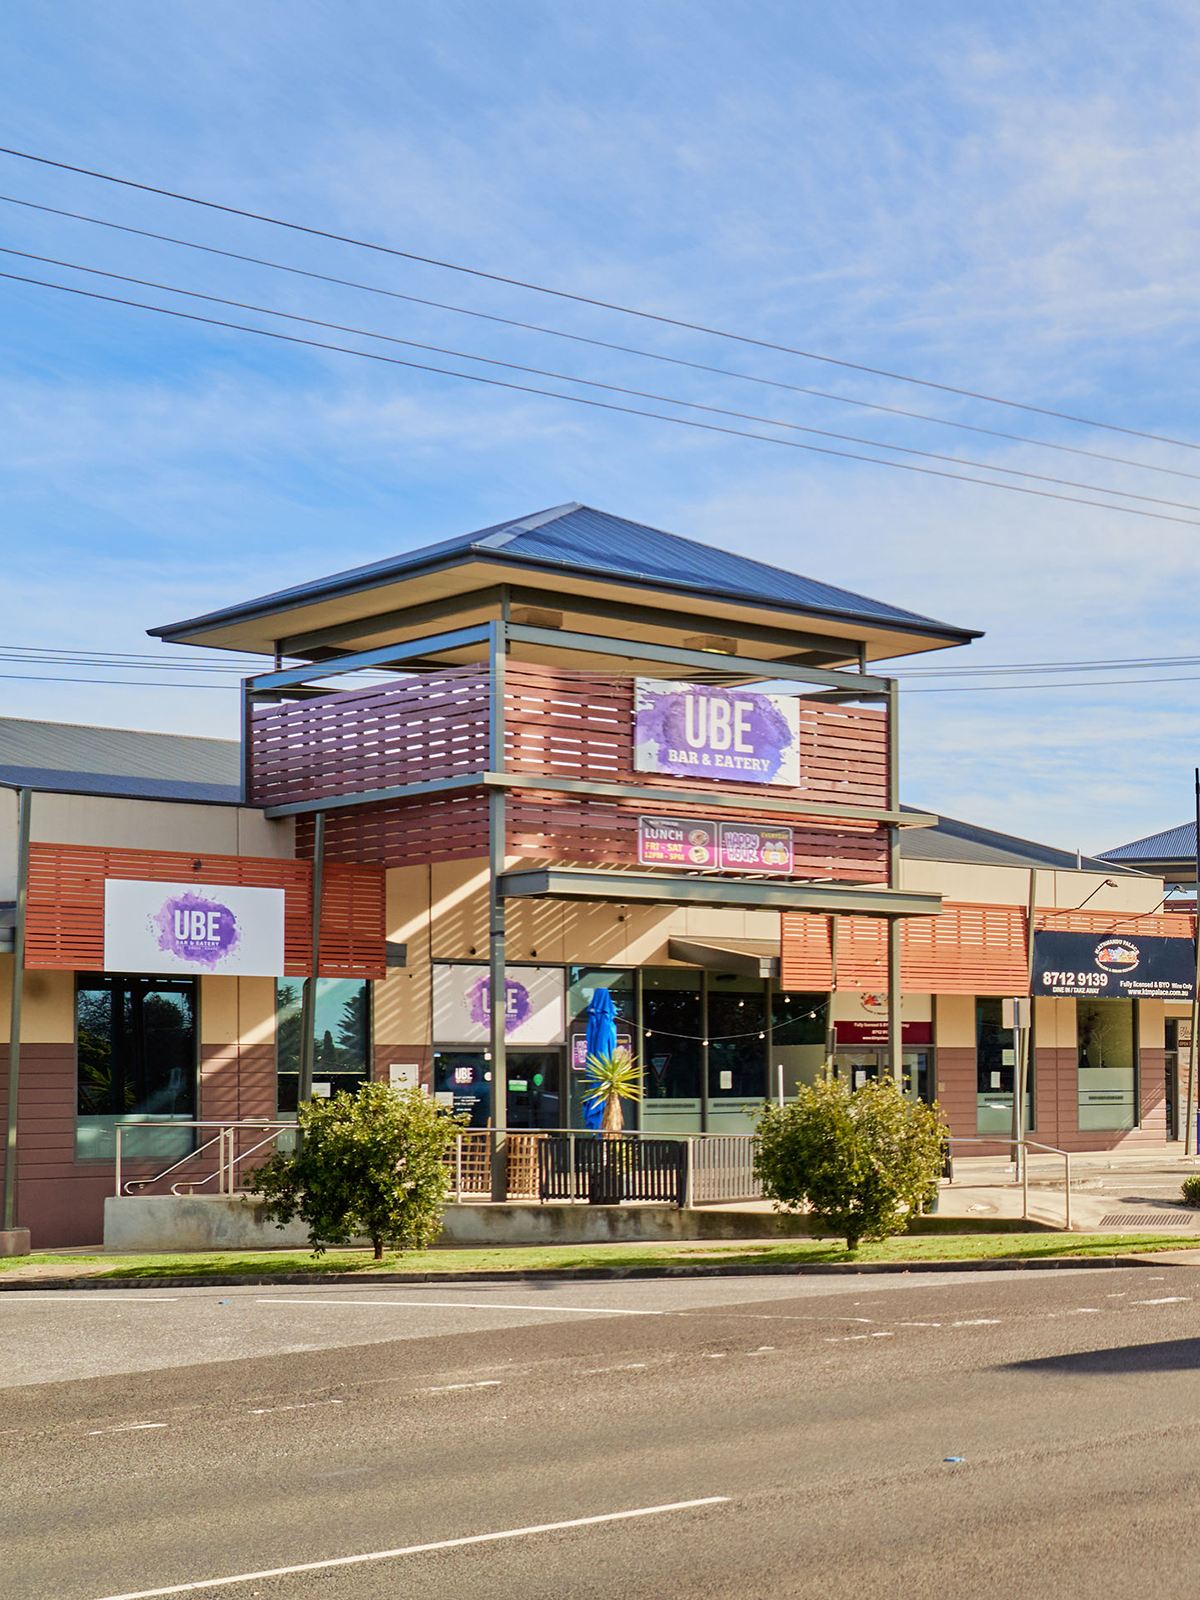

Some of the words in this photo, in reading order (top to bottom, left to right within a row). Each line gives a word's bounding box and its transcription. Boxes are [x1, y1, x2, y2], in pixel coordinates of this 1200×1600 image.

[685, 694, 754, 754] UBE
[668, 749, 699, 765] BAR
[702, 753, 711, 766] &
[714, 754, 771, 772] EATERY
[644, 828, 684, 841] LUNCH
[724, 832, 760, 849] HAPPY
[645, 841, 660, 850] FRI
[667, 843, 683, 852] SAT
[727, 846, 760, 863] HOUR
[174, 909, 221, 941] UBE
[1043, 971, 1075, 986] 8712
[1077, 972, 1108, 987] 9139
[1120, 980, 1132, 989] Fully
[482, 988, 518, 1014] UE
[455, 1067, 473, 1080] UBE
